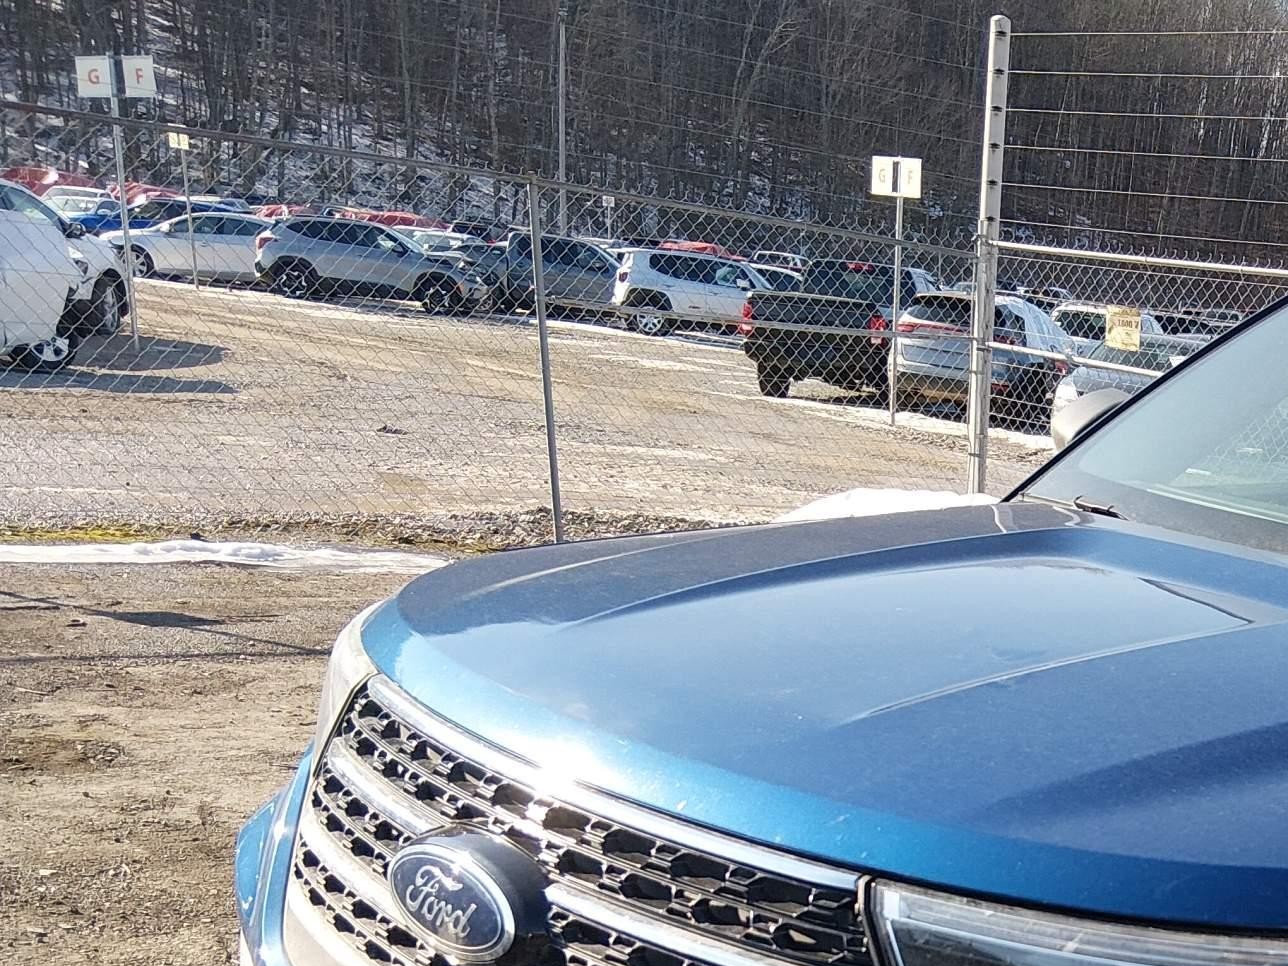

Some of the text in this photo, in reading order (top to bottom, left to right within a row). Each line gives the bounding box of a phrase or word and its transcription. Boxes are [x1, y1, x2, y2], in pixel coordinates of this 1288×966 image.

[87, 68, 100, 85] G
[135, 68, 144, 85] F
[878, 168, 887, 184] G
[405, 865, 479, 938] Ford
